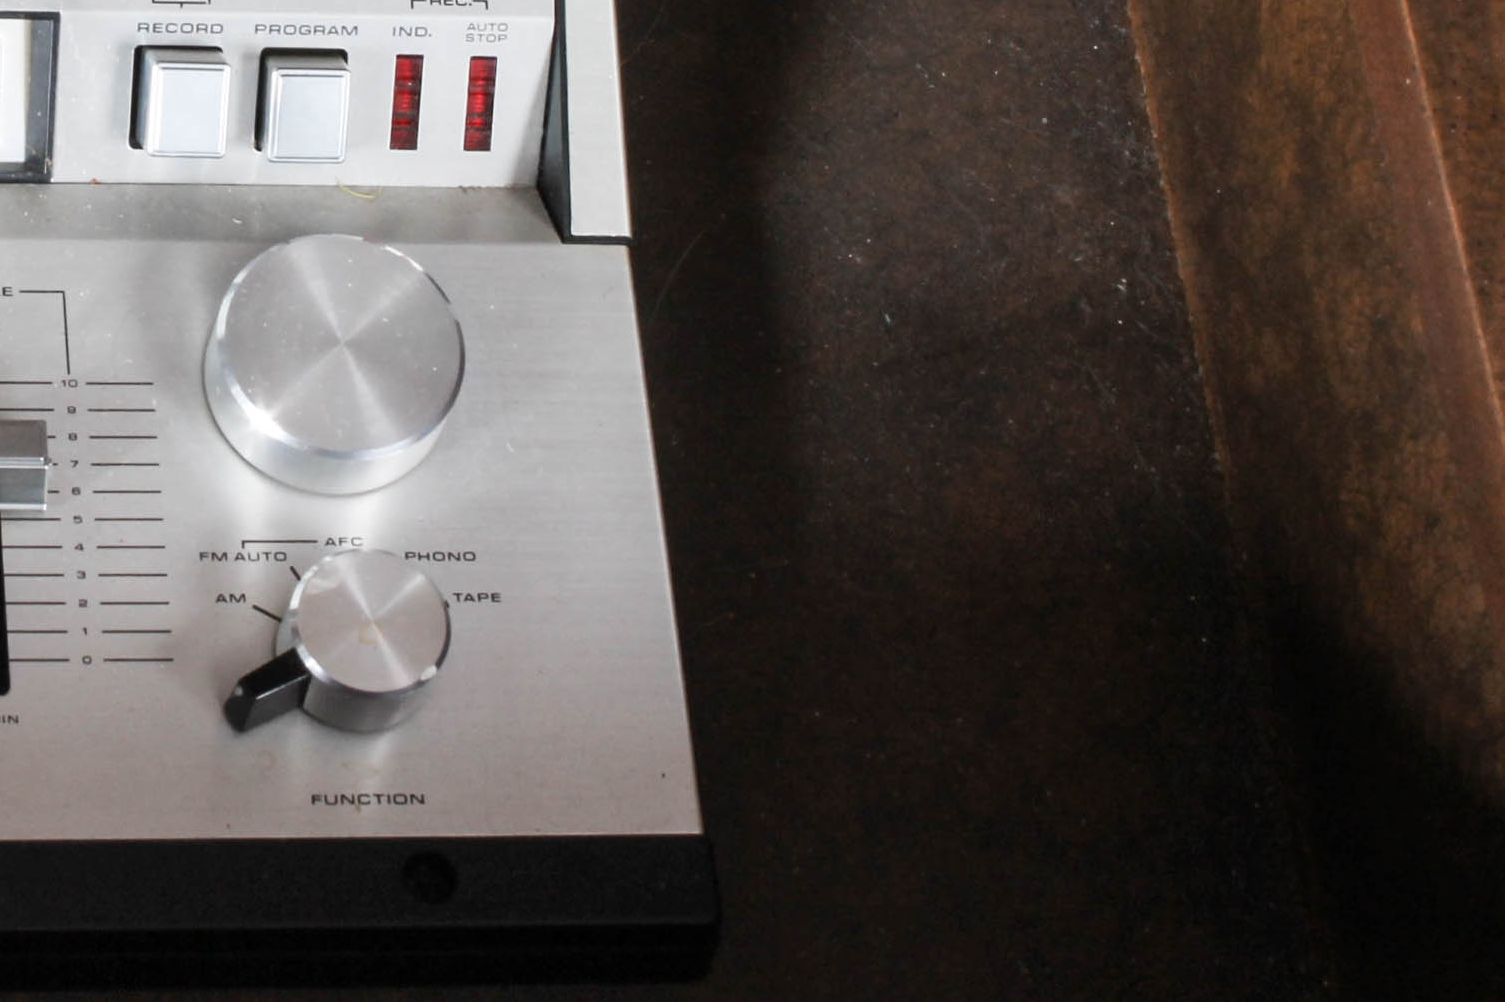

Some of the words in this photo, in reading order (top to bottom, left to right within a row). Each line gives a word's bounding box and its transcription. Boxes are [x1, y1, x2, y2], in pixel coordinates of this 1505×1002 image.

[136, 22, 224, 35] RECORD
[254, 23, 359, 36] PROGRAM
[392, 26, 432, 38] IND.
[466, 22, 509, 33] AUTO
[465, 32, 508, 44] STOP
[60, 378, 79, 389] 10
[66, 405, 77, 415] 9
[67, 432, 78, 442] 8
[70, 459, 80, 469] 7
[70, 486, 82, 496] 6
[72, 515, 84, 525] 5
[74, 543, 85, 552] 4
[325, 537, 363, 547] AFC
[198, 551, 228, 562] FM
[233, 550, 288, 563] AUTO
[404, 550, 477, 562] PHONO
[76, 570, 87, 580] 3
[214, 593, 247, 604] AM
[452, 592, 502, 603] TAPE
[78, 598, 88, 609] 2
[82, 626, 88, 636] 1
[81, 655, 93, 666] 0
[310, 792, 426, 805] FUNCTION
